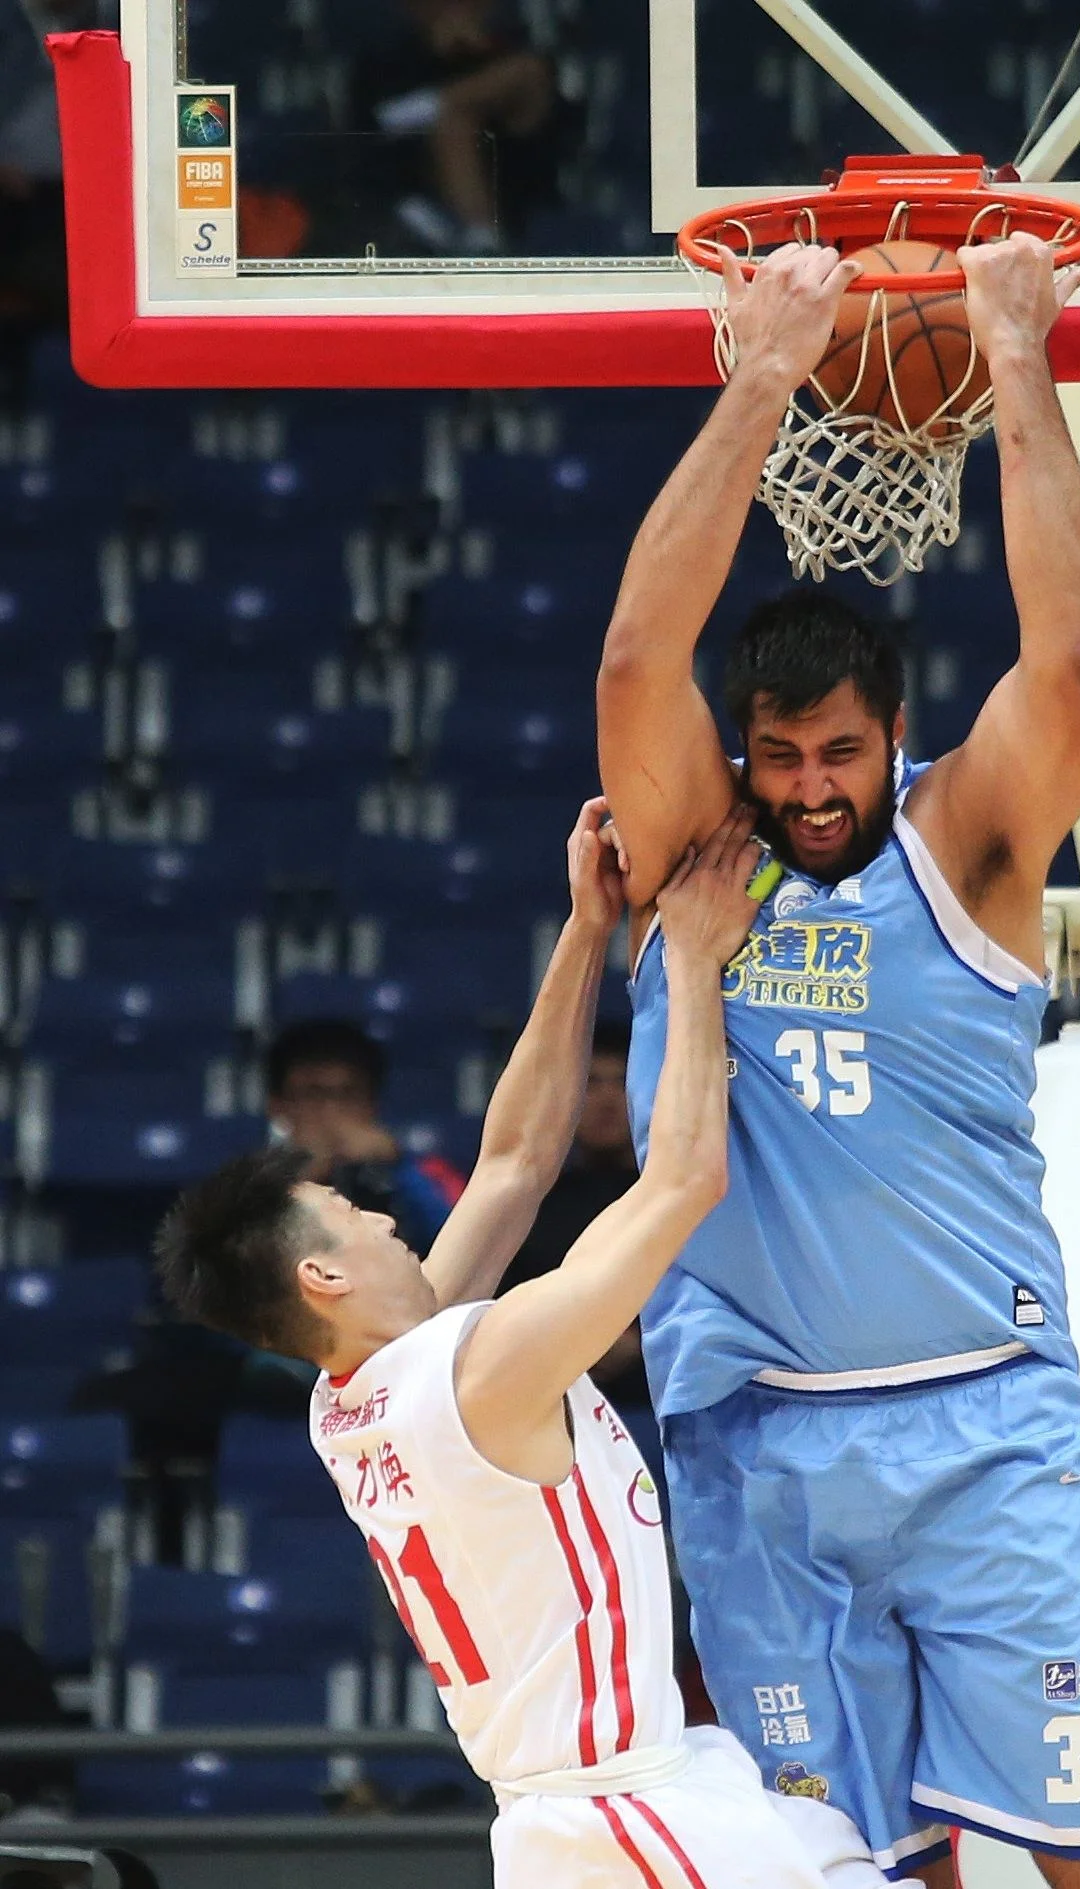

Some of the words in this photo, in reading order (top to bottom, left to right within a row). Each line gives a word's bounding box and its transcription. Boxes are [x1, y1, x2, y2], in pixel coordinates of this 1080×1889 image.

[185, 161, 224, 180] FIBA
[749, 980, 867, 1009] TIGERS
[775, 1029, 873, 1116] 35
[752, 1683, 805, 1714] 日立
[760, 1715, 812, 1746] 冷氣
